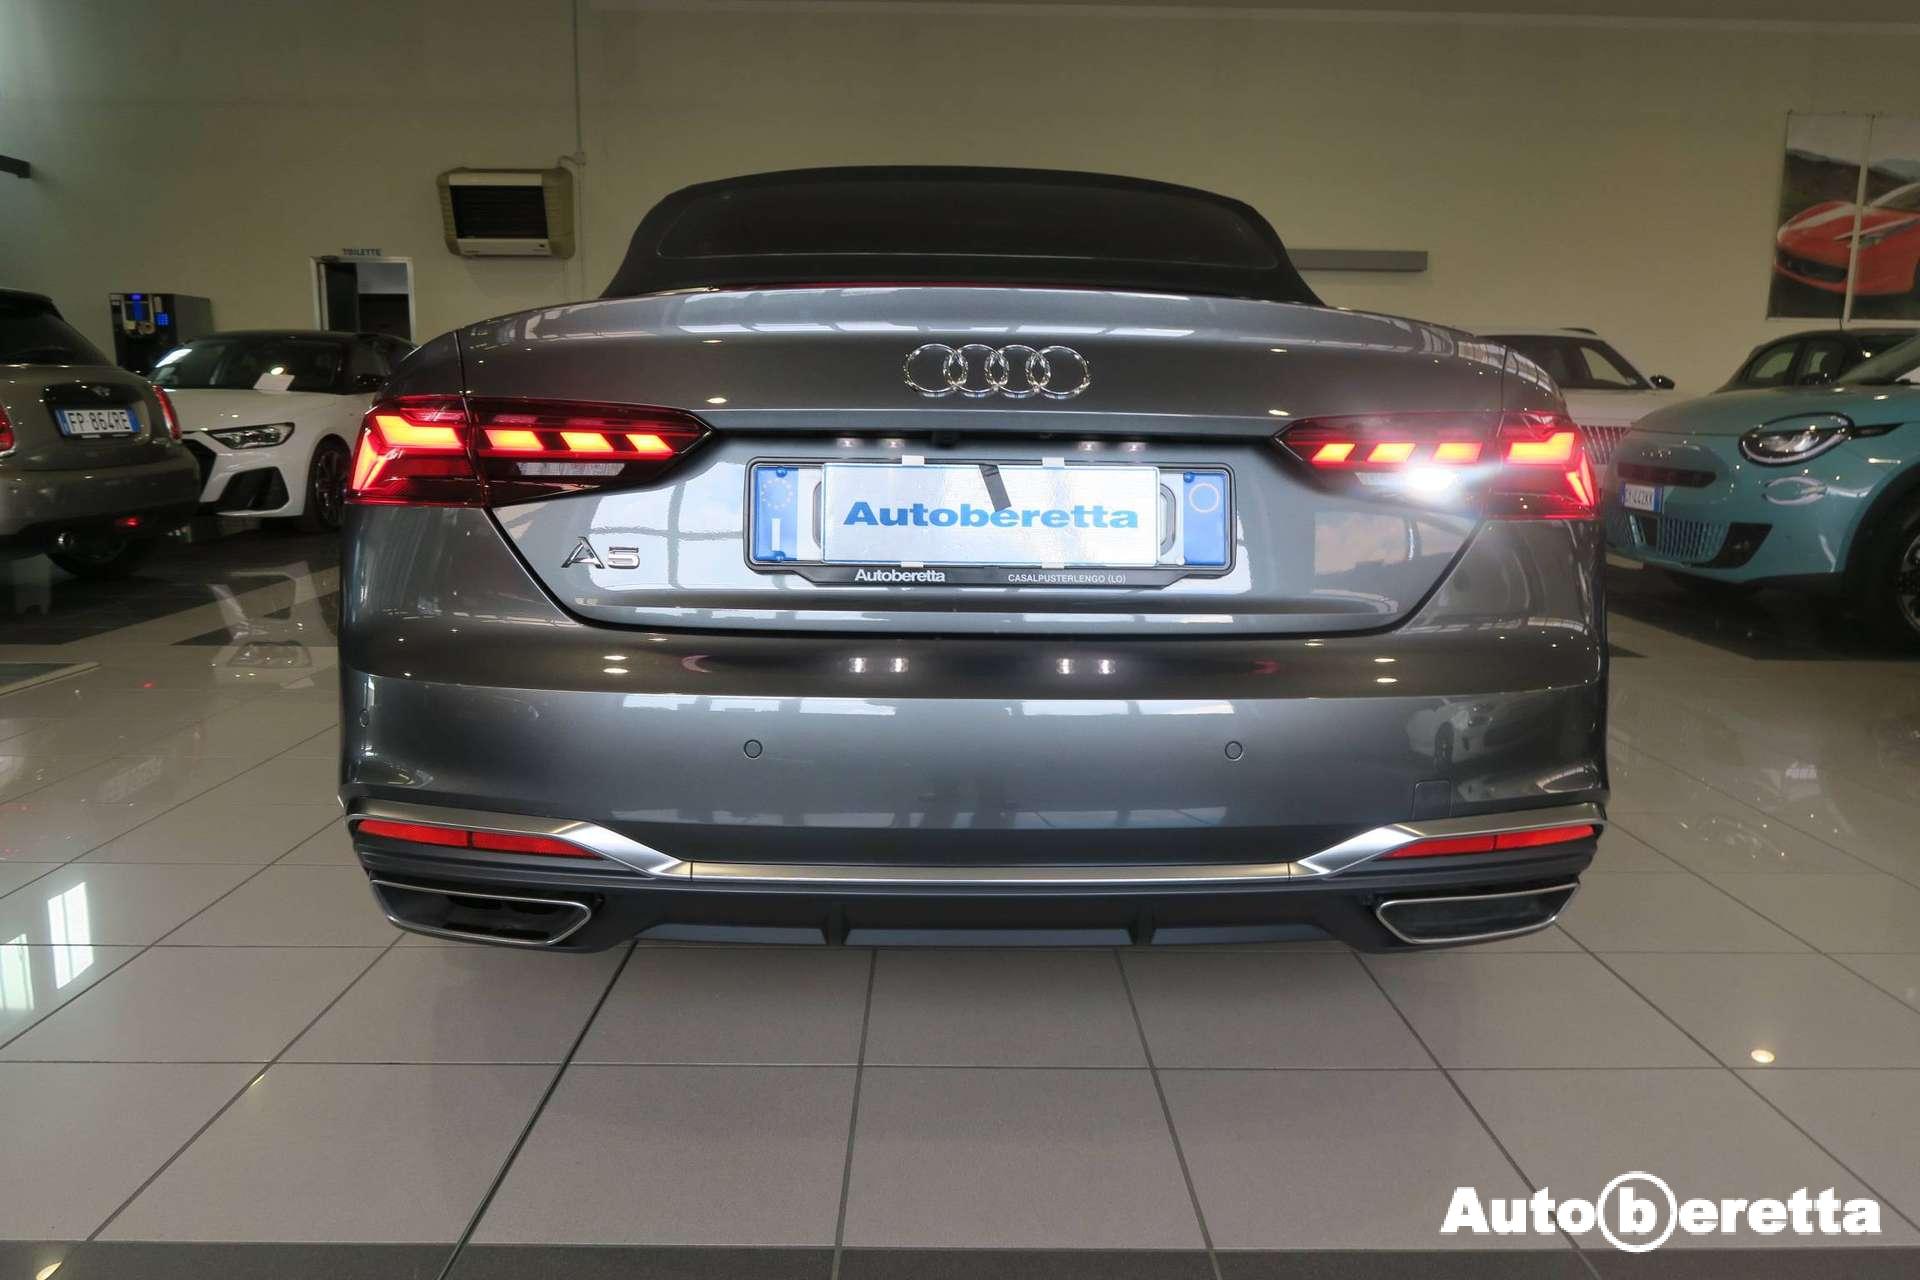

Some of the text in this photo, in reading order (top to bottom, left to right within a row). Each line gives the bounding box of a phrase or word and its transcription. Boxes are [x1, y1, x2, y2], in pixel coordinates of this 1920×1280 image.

[342, 247, 383, 256] TOILETTE
[67, 412, 85, 432] FP
[843, 501, 1139, 529] Autoberetta
[560, 535, 641, 570] A5
[854, 568, 946, 583] Autoberetta
[1007, 573, 1127, 585] CASALPUSTERLENGO (LO)
